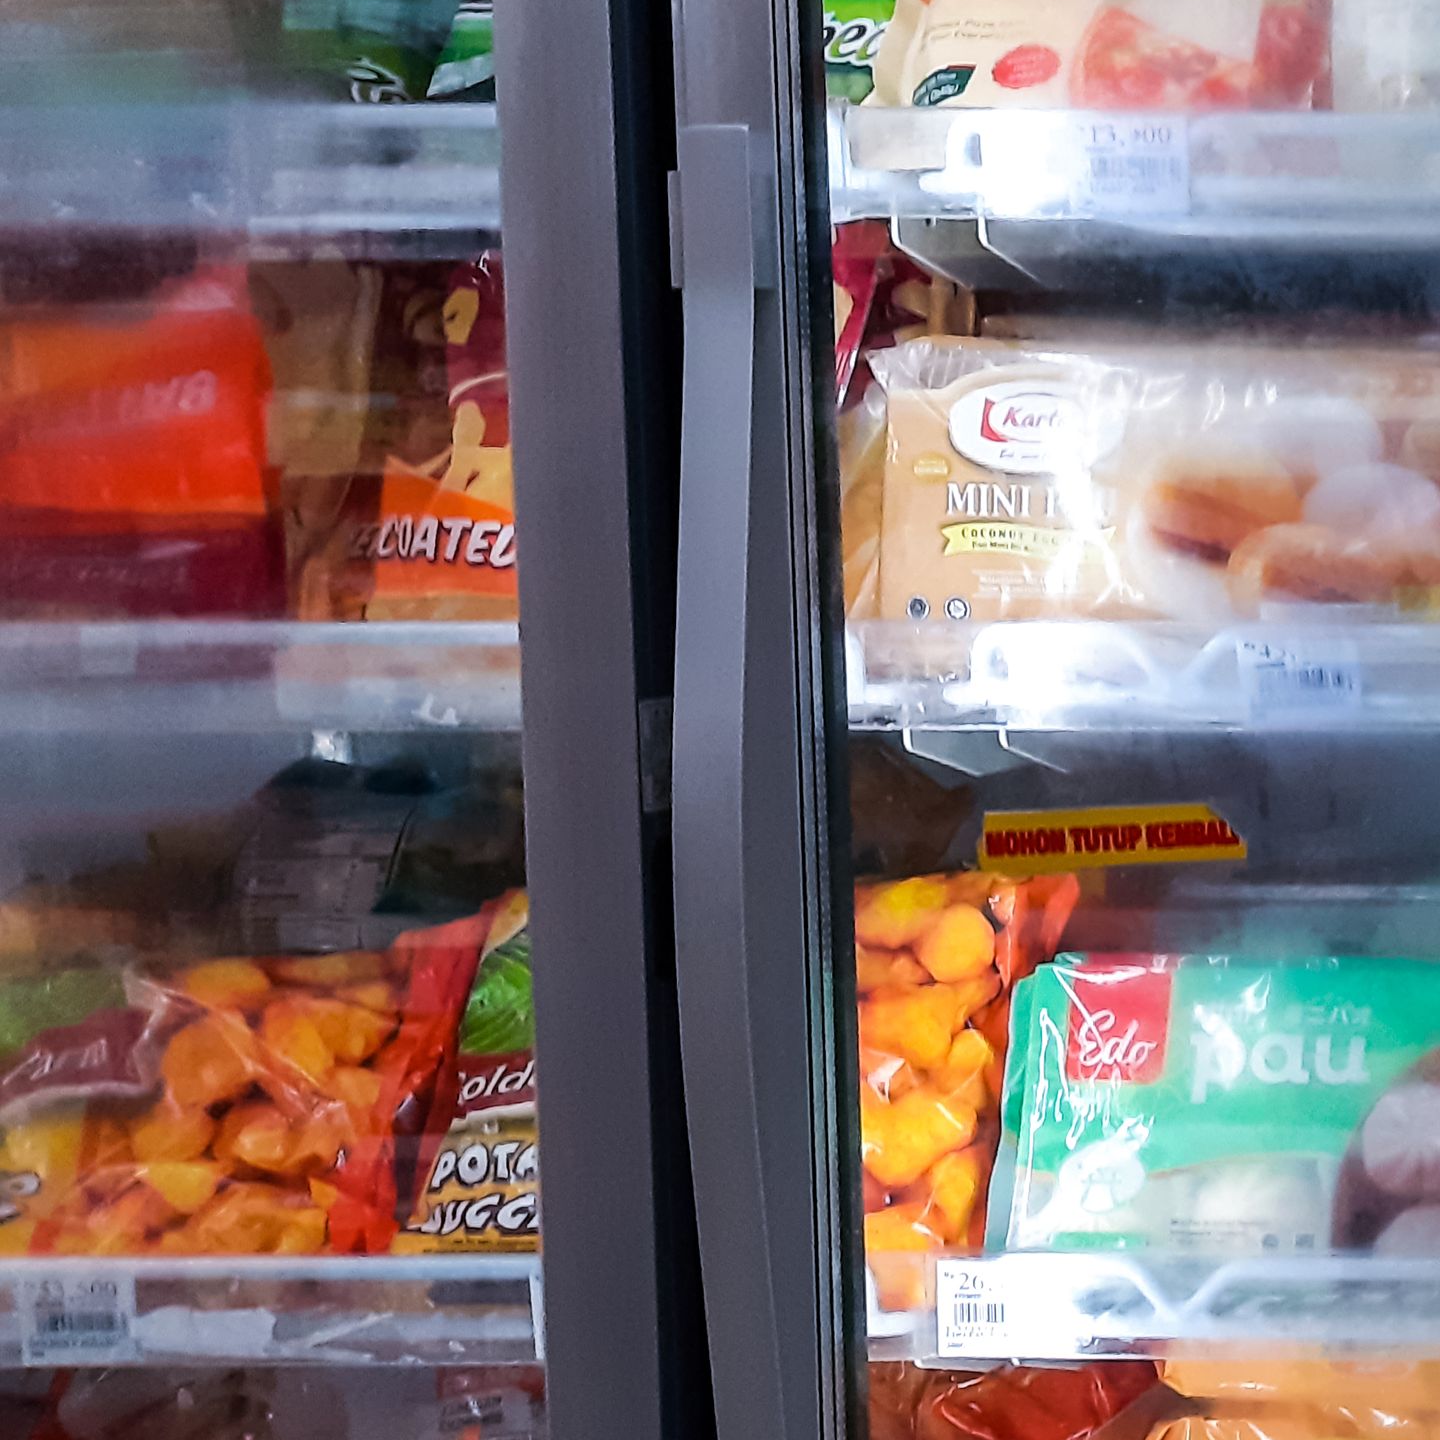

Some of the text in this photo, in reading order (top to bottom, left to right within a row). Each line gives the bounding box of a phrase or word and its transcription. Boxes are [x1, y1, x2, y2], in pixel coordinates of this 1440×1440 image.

[1002, 405, 1068, 429] Kart
[945, 481, 1033, 518] MINI
[985, 827, 1068, 858] MOHON
[1072, 822, 1143, 854] TUTUP
[1078, 1011, 1371, 1105] Edo pau
